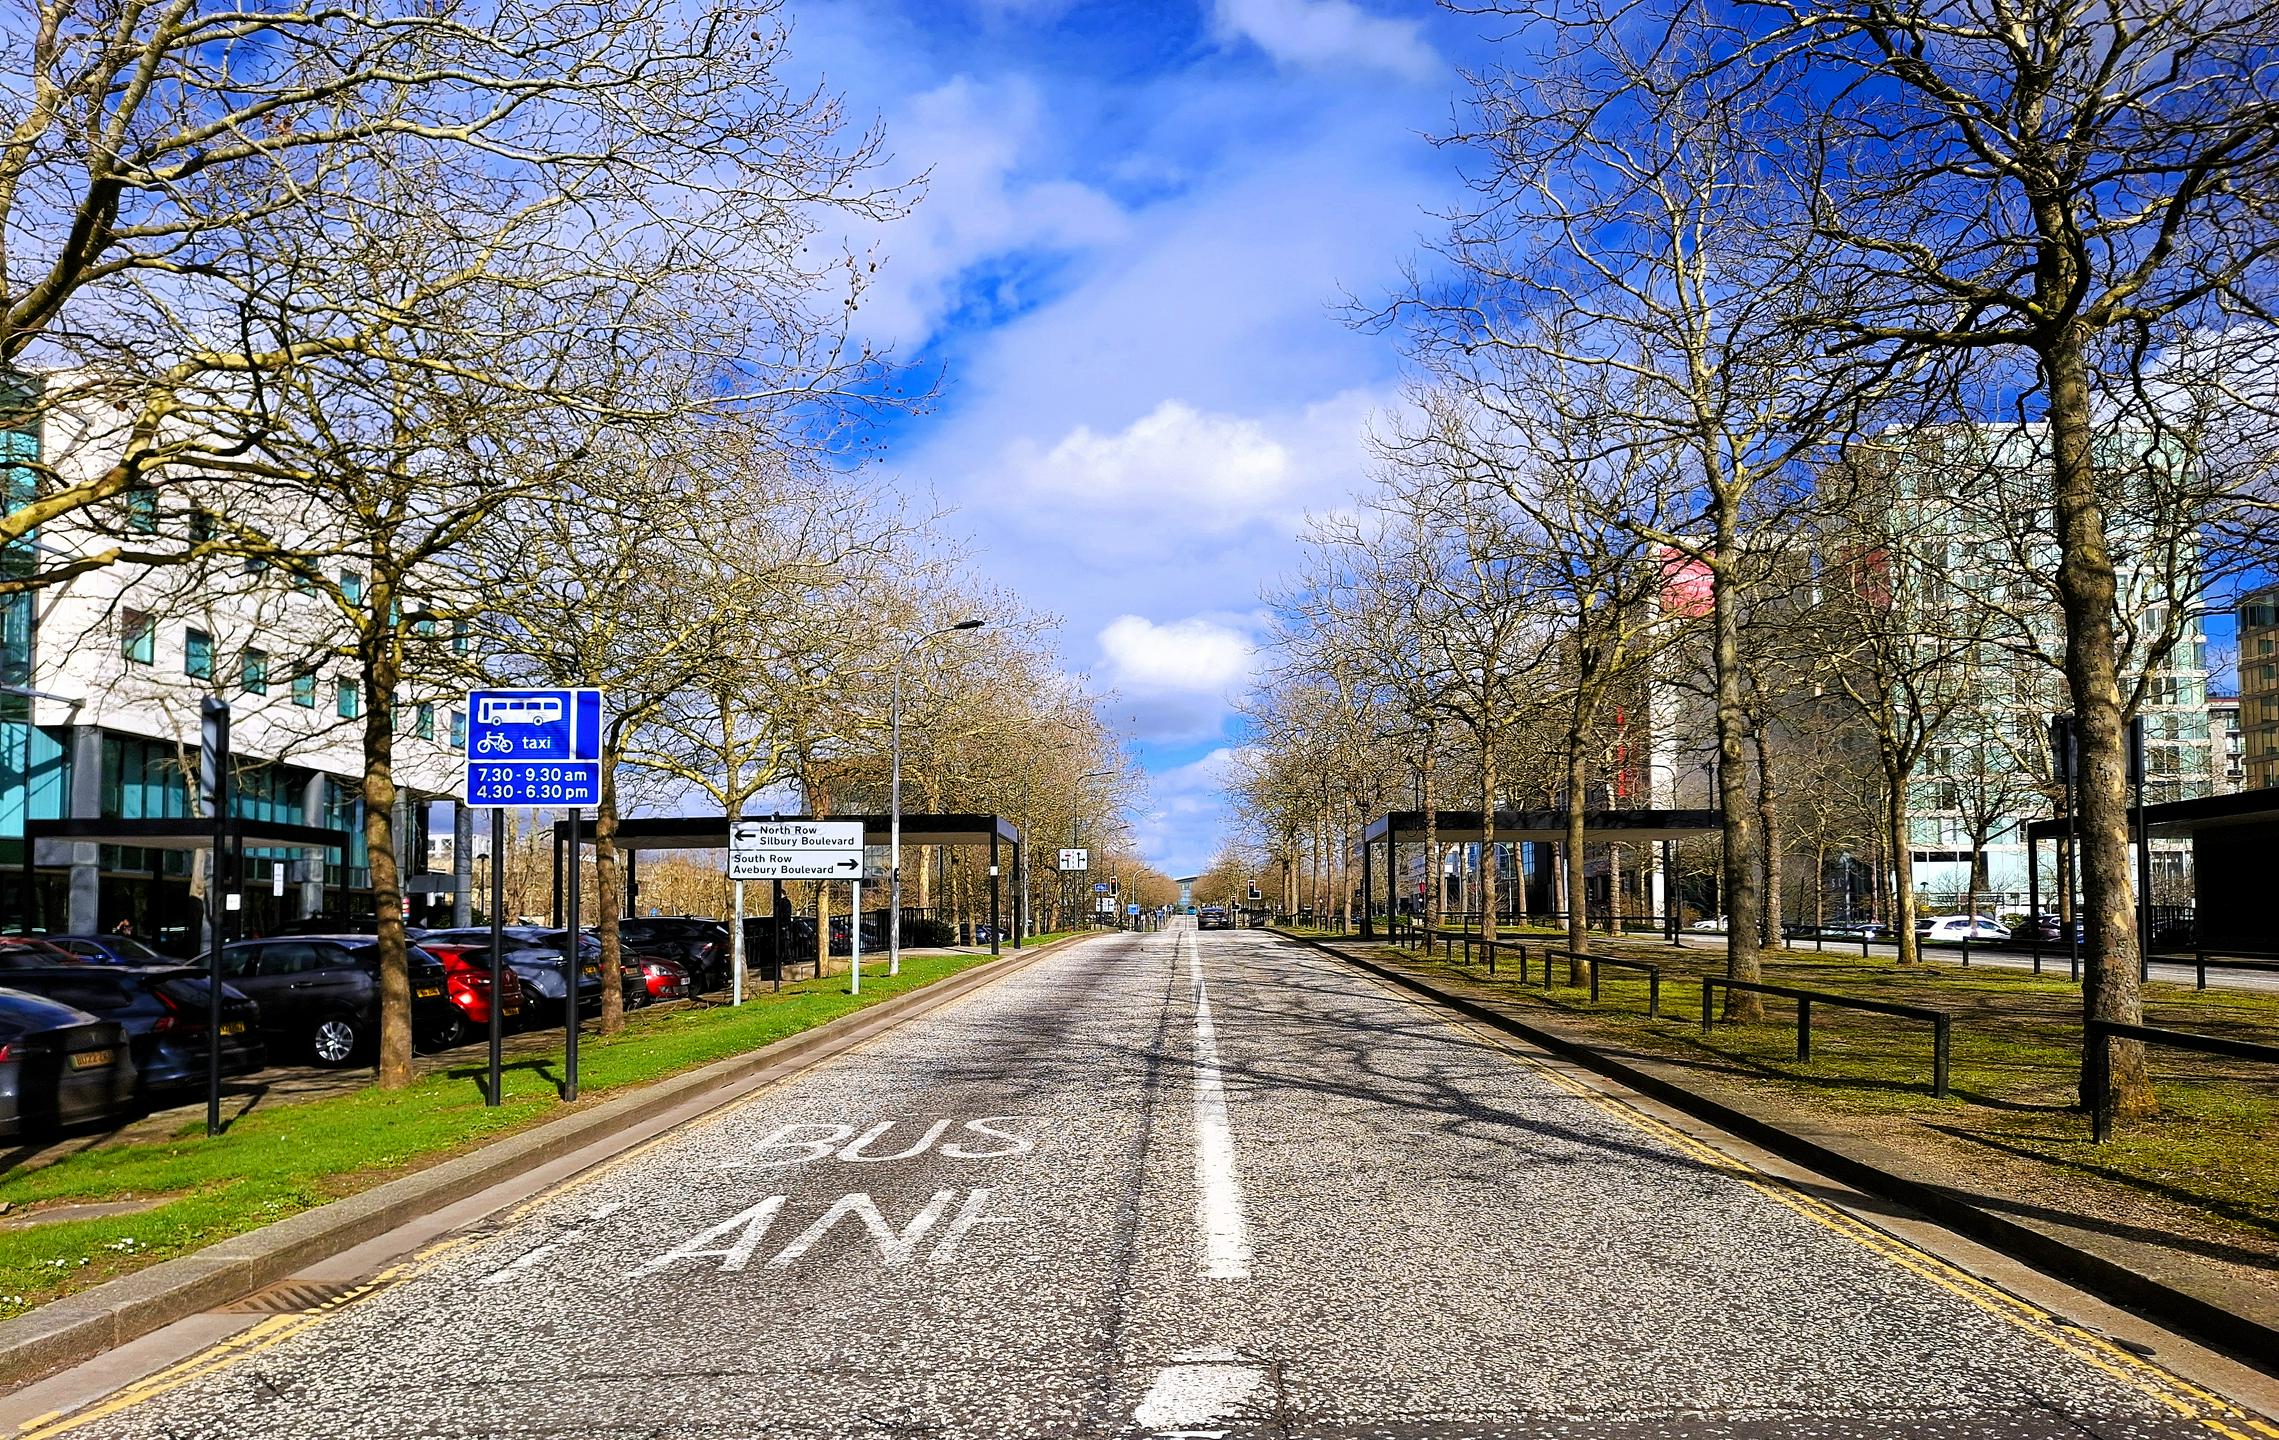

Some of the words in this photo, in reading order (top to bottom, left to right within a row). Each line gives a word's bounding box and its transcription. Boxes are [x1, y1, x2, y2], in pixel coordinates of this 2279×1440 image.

[522, 736, 551, 749] taxi
[478, 768, 513, 782] 7.30
[525, 768, 561, 782] 9.30
[564, 771, 587, 782] am
[477, 785, 513, 798] 4.30
[525, 785, 562, 798] 6.30
[565, 787, 588, 800] pm
[760, 826, 791, 835] North
[795, 826, 817, 835] Row
[760, 837, 798, 847] Silbury
[801, 837, 855, 846] Boulevard
[733, 854, 766, 863] South
[769, 854, 793, 863] Row
[733, 866, 777, 875] Avebury
[781, 866, 834, 874] Boulevard
[715, 1115, 1037, 1169] BUS
